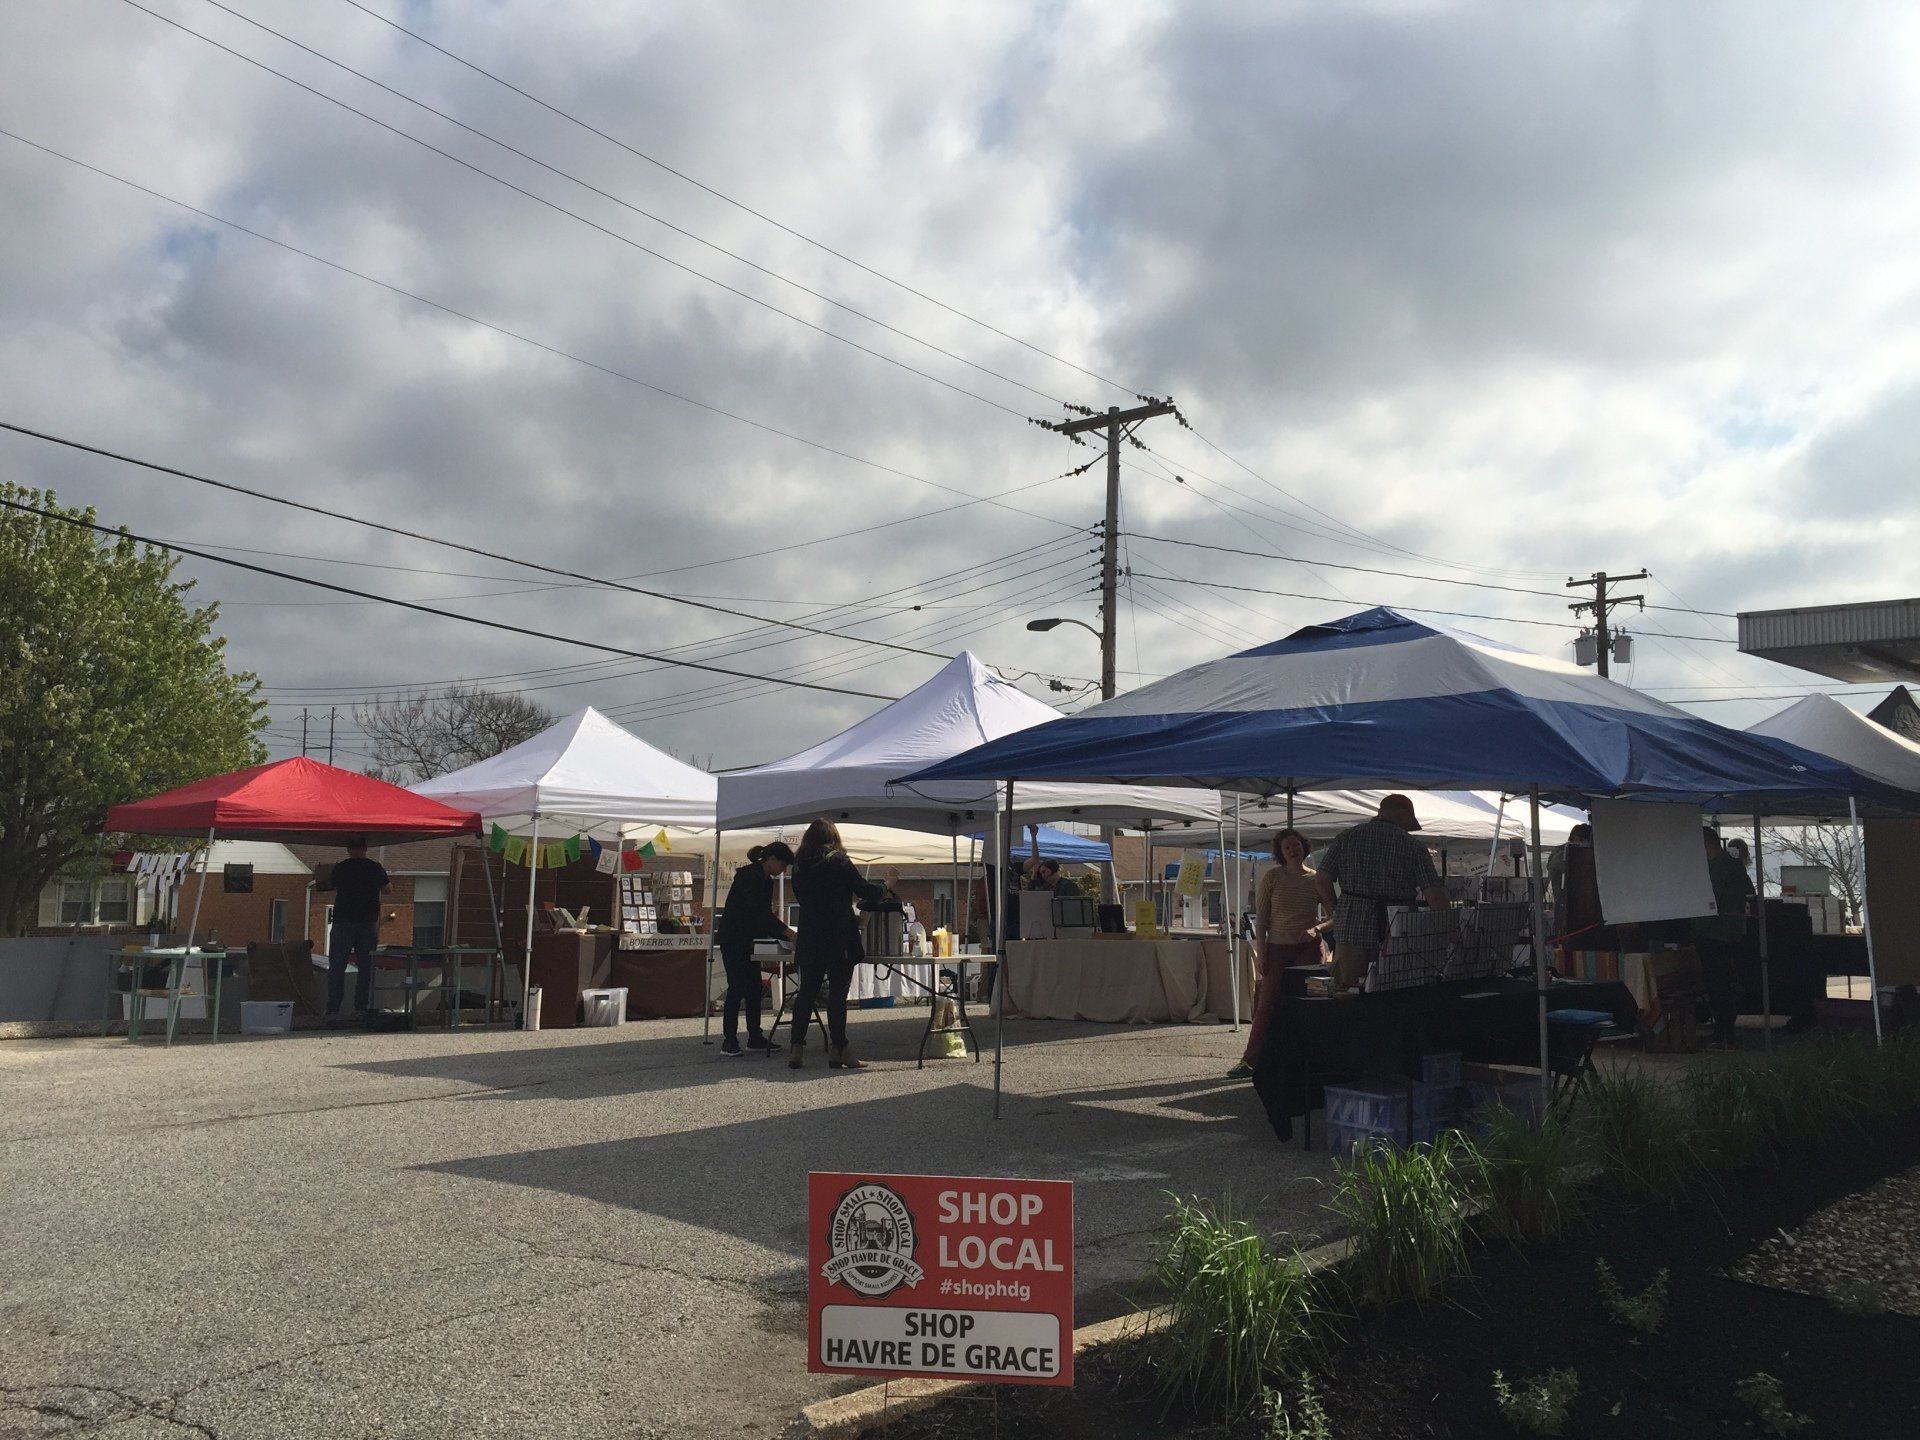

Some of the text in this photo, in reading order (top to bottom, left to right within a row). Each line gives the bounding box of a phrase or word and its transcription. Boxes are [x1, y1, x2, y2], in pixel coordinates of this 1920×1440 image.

[630, 937, 704, 947] BOWERBOX PRESS
[834, 1190, 869, 1248] SHOP SMALL
[876, 1190, 911, 1249] SHOP LOCAL
[938, 1190, 1043, 1226] SHOP
[827, 1252, 919, 1277] SHOP HAVRE DE GRACE
[938, 1235, 1064, 1272] LOCAL
[846, 1271, 864, 1287] SUPPORT
[940, 1278, 1031, 1302] #shophdg
[904, 1312, 975, 1338] SHOP
[826, 1338, 1053, 1373] HAVRE DE GRACE
